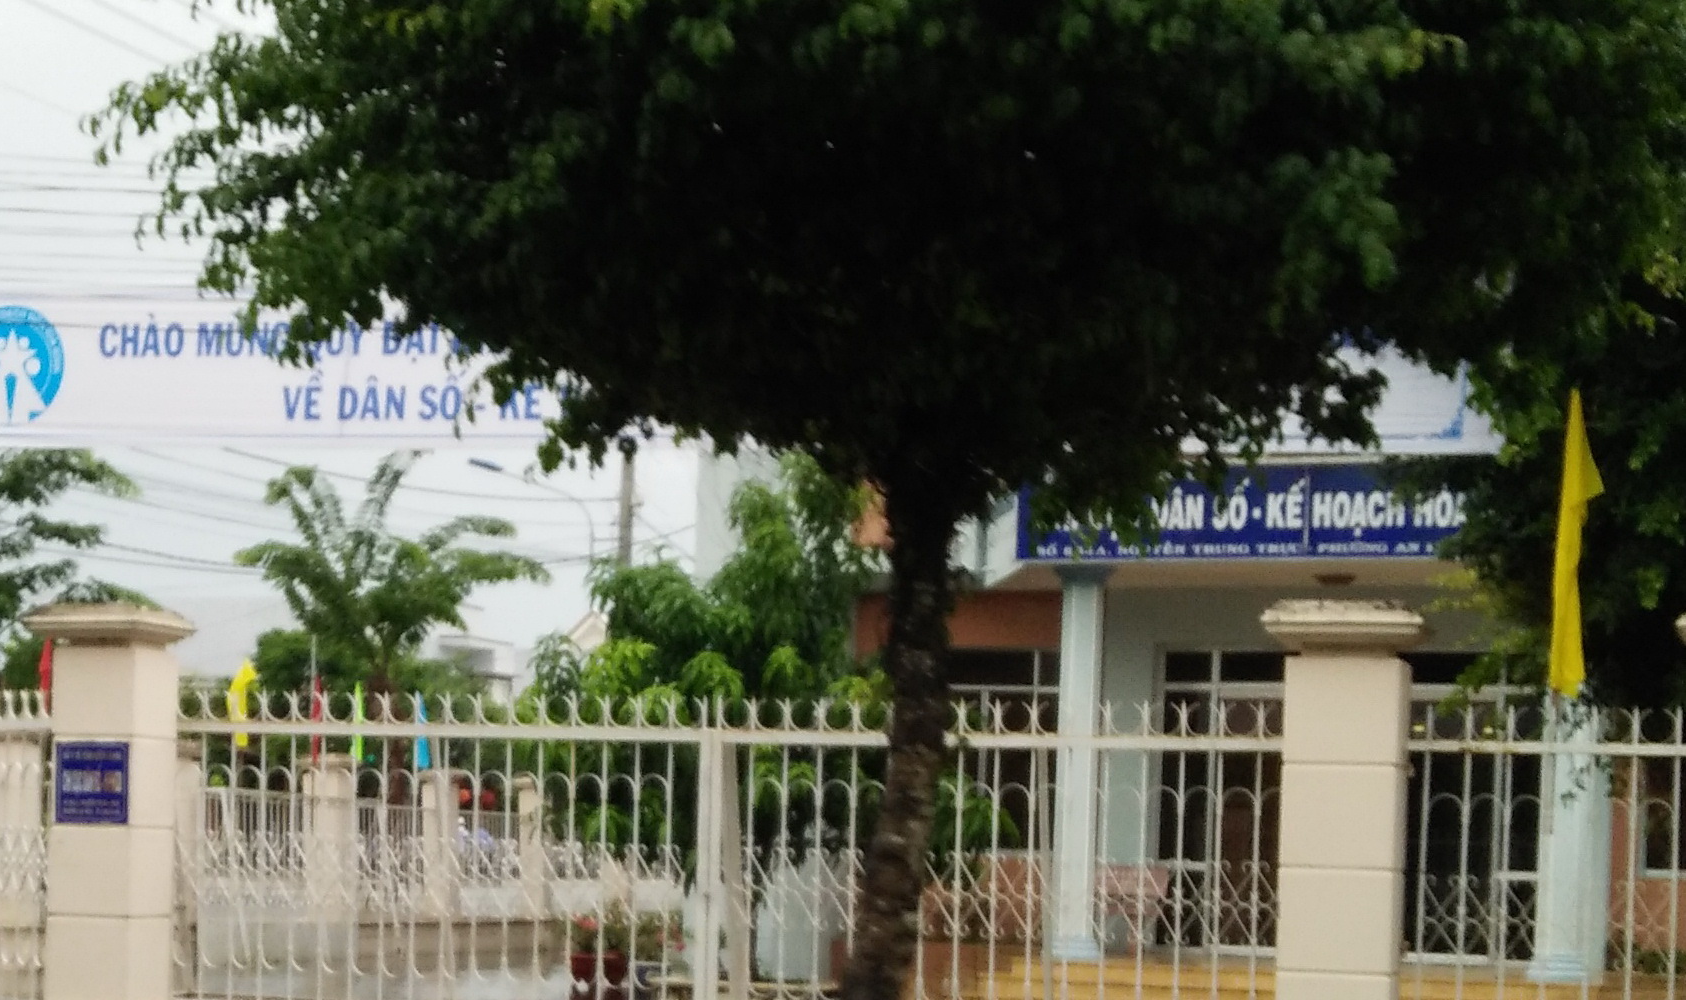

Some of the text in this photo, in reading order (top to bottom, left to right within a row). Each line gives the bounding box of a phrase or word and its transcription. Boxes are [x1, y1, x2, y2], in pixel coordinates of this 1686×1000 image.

[99, 312, 185, 358] CHÀO
[339, 375, 406, 420] DÂN
[419, 369, 464, 421] SỐ
[1266, 477, 1304, 529] KẾ
[1312, 490, 1406, 538] HOẠCH
